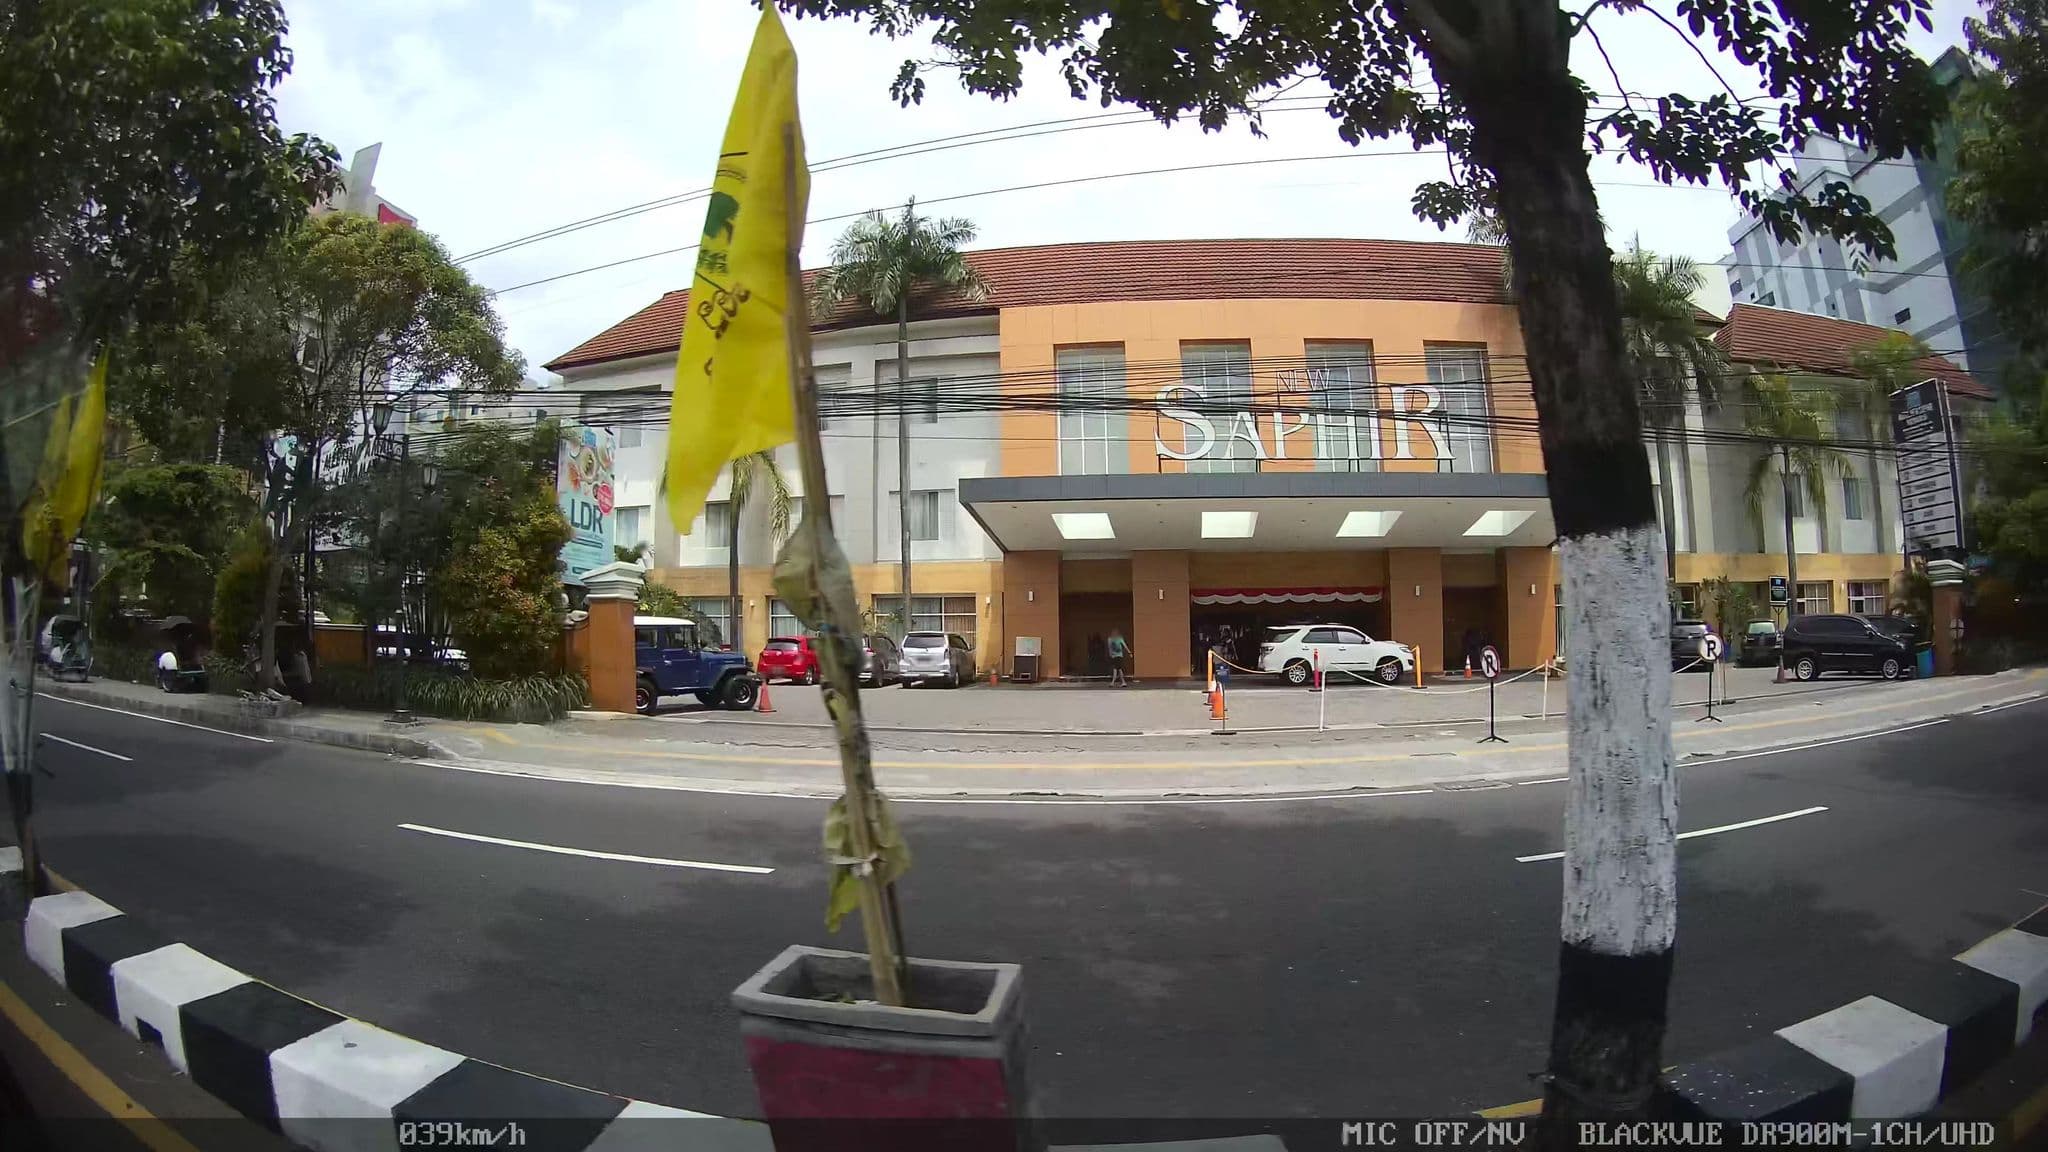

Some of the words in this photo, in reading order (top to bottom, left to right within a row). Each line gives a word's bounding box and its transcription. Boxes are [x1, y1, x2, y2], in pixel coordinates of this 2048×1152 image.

[1277, 368, 1330, 392] NEW
[1154, 384, 1456, 460] SAPHIR
[571, 498, 603, 534] LDR
